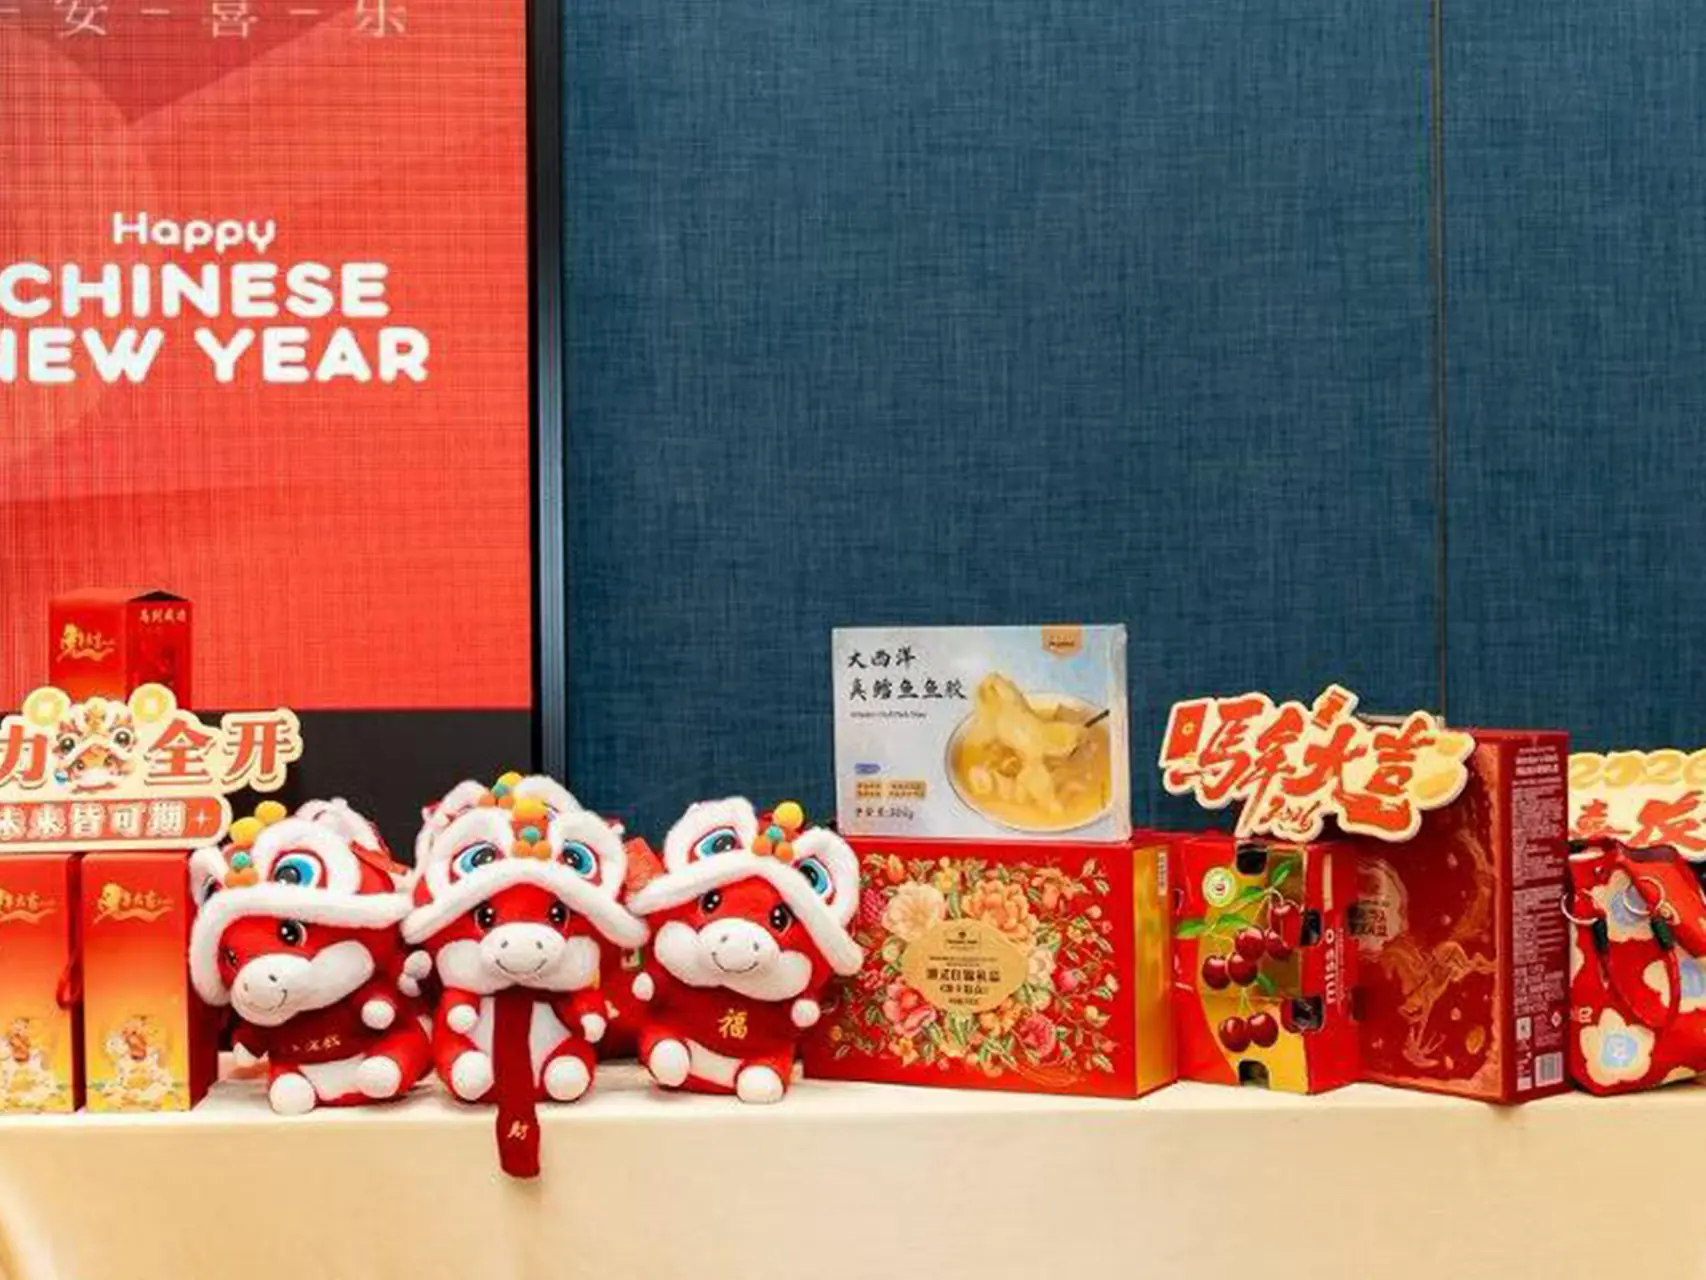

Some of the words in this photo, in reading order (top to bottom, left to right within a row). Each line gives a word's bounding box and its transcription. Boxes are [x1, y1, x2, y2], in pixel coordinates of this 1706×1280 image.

[112, 211, 276, 253] Happy
[0, 261, 390, 318] CHINESE
[194, 326, 430, 383] YEAR
[848, 646, 917, 670] 大西洋
[716, 1007, 748, 1040] 福
